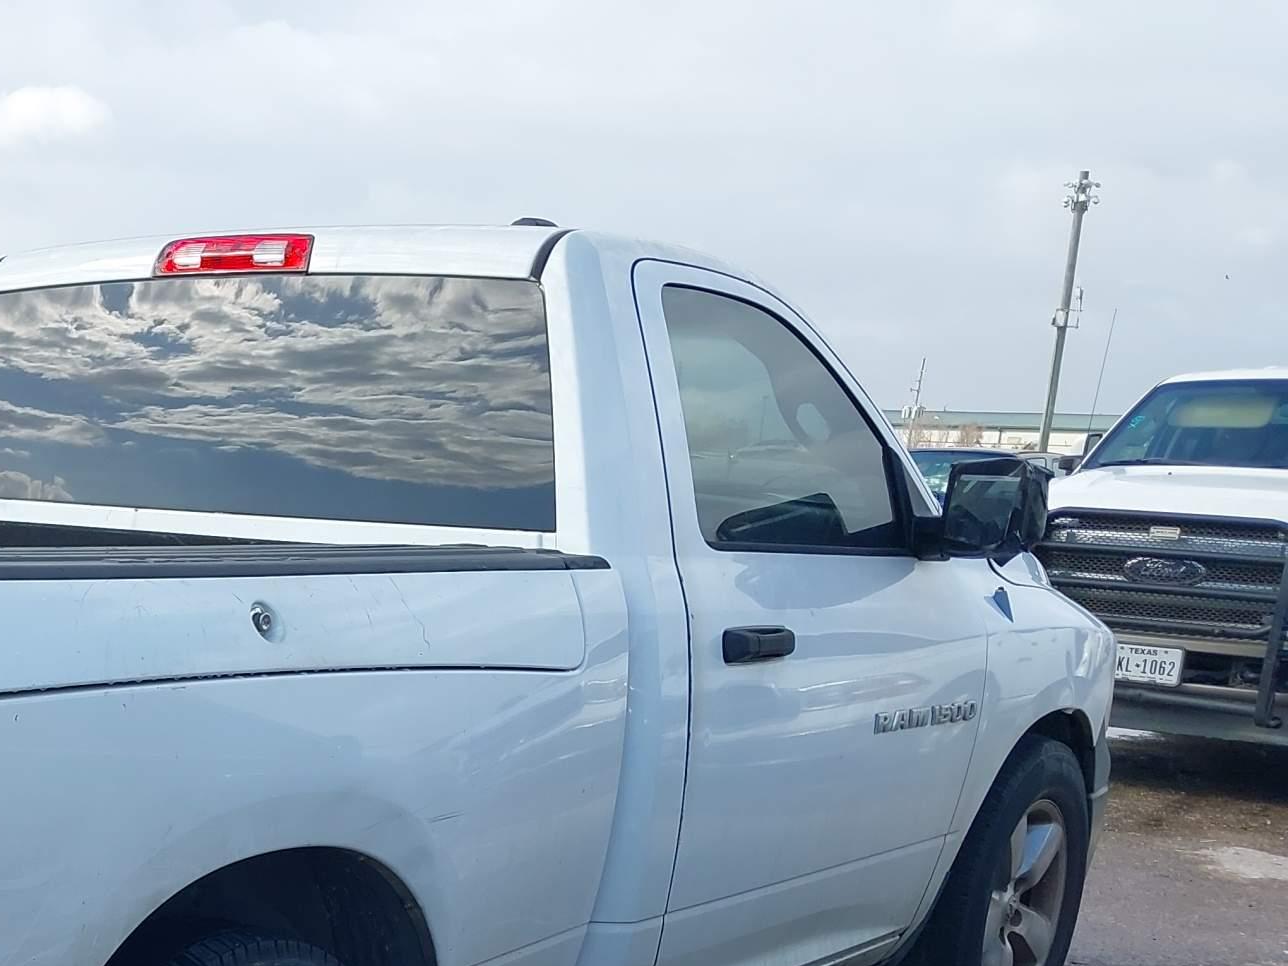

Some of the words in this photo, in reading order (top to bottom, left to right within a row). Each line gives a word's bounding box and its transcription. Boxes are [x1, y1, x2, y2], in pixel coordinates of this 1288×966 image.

[1128, 647, 1158, 656] TEXAS
[873, 709, 930, 735] RAM
[930, 700, 977, 727] 1500
